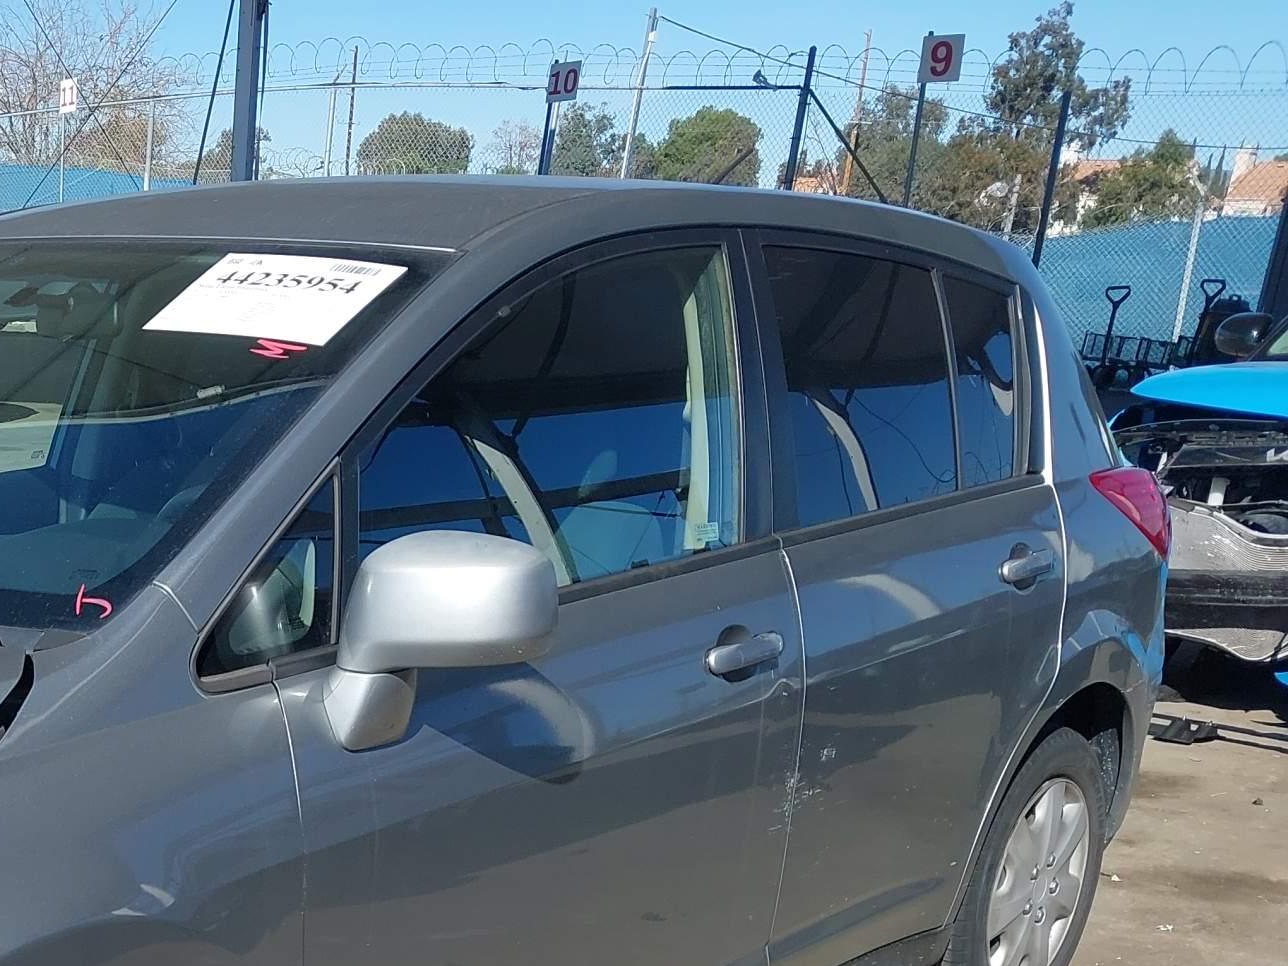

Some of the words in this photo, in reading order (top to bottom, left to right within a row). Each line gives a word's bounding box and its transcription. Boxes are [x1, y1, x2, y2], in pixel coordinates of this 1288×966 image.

[930, 41, 953, 77] 9
[548, 68, 578, 95] 10
[62, 85, 75, 107] 11
[216, 271, 363, 295] 44235954
